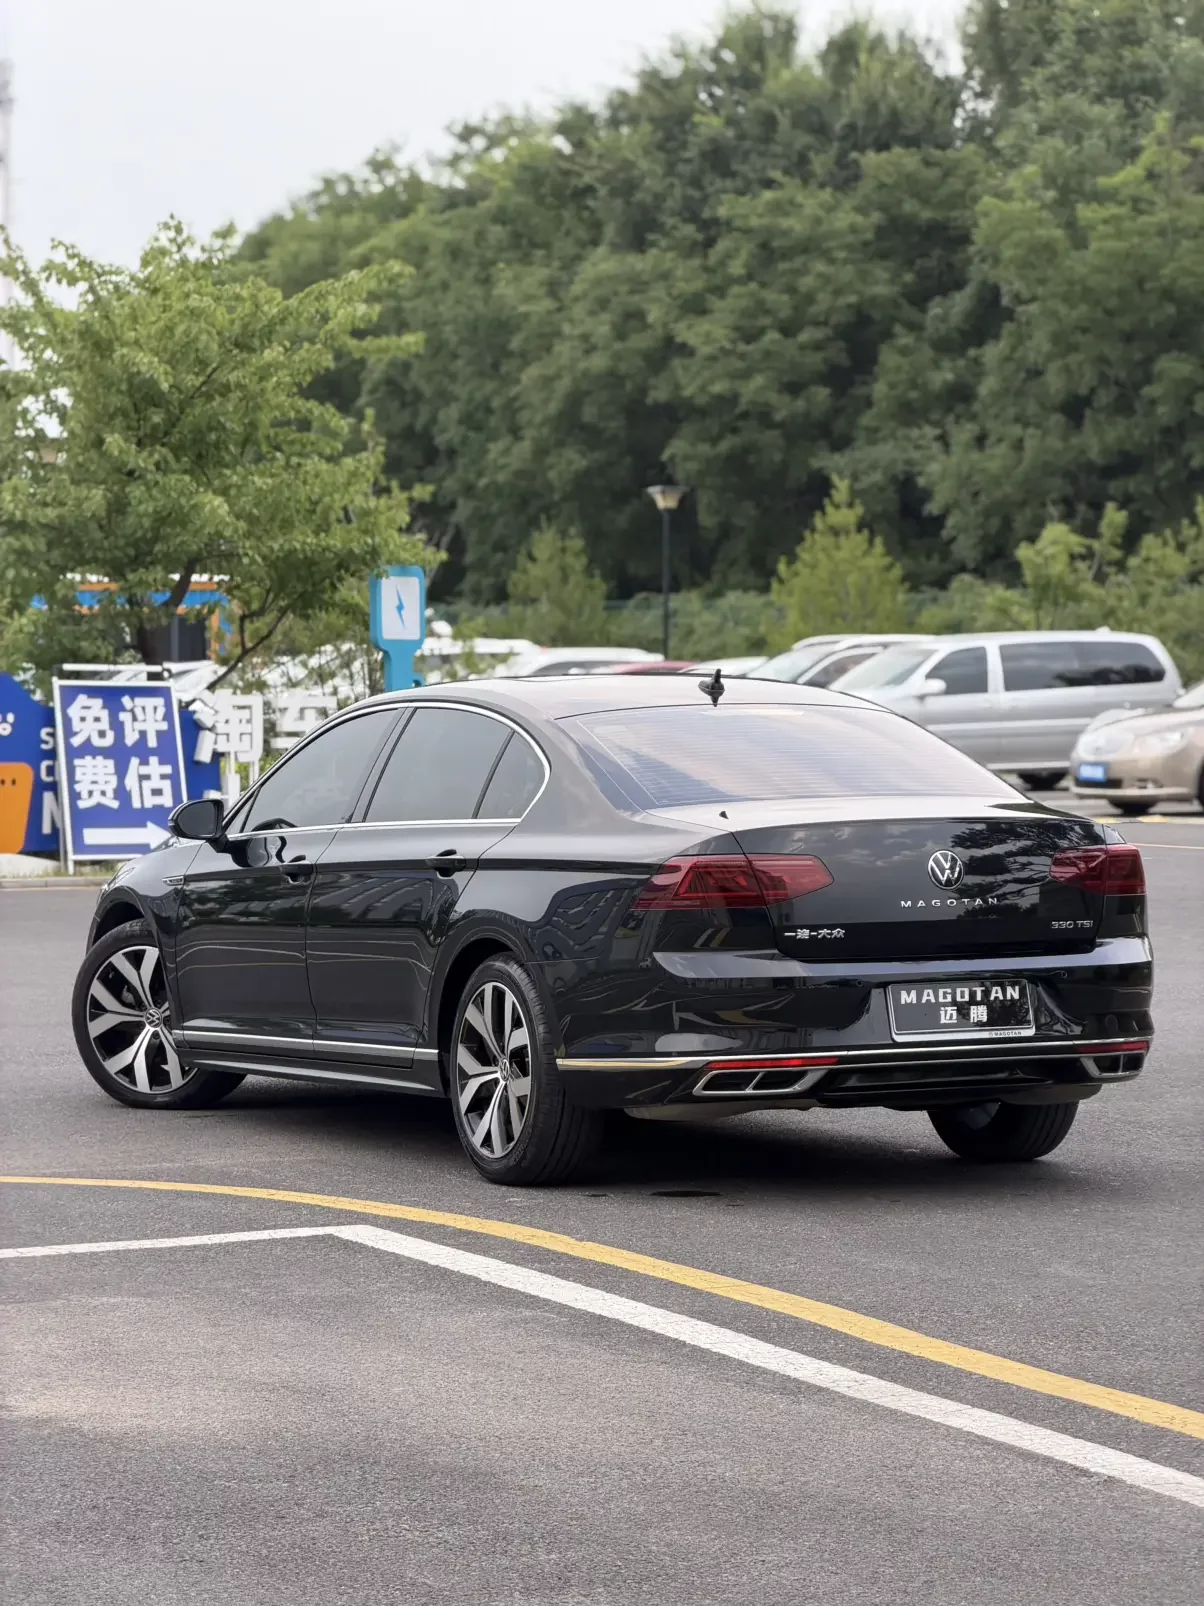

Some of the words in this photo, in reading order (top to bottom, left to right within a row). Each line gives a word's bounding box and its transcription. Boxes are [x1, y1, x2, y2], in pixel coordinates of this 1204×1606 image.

[900, 898, 998, 908] MAGOTAN
[1051, 921, 1074, 929] 330
[900, 985, 1020, 1005] MAGOTAN
